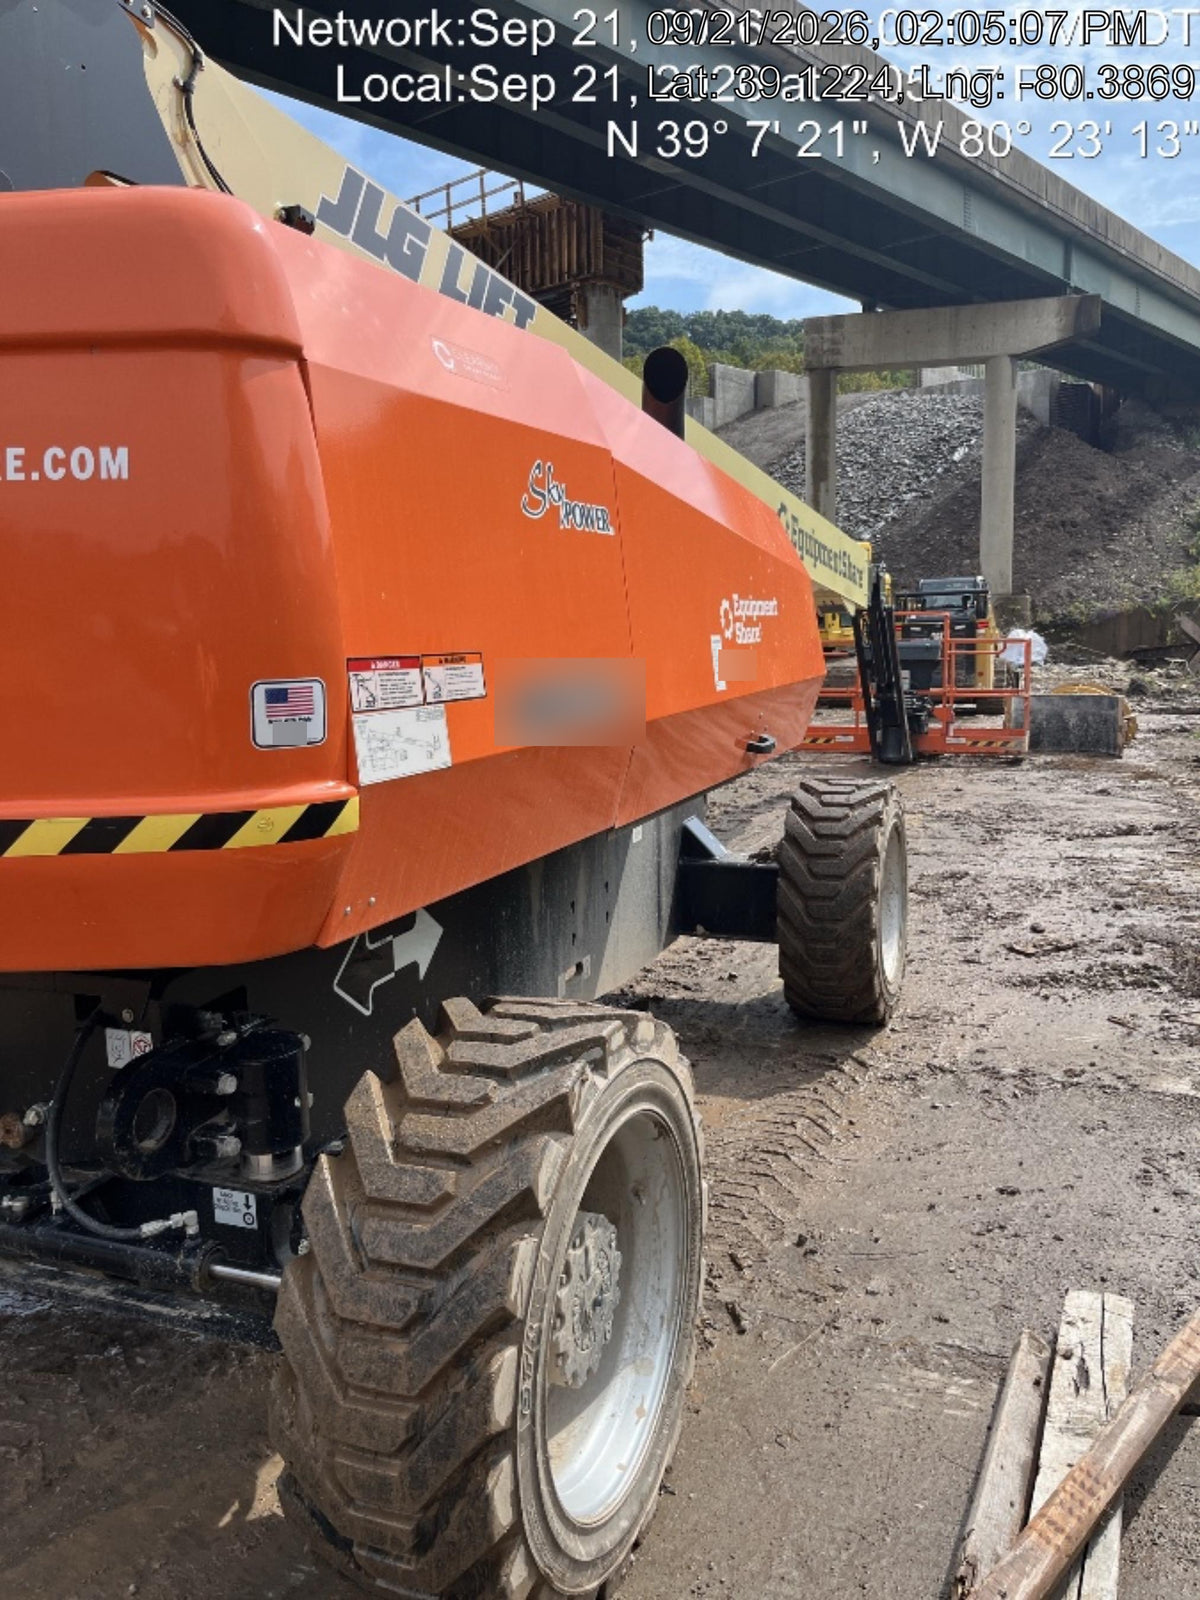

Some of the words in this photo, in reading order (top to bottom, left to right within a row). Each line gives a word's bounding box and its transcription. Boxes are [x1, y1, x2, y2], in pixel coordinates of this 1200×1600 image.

[315, 163, 432, 284] JLG
[438, 239, 538, 330] LIFT
[521, 459, 567, 519] Sky
[560, 499, 615, 536] POWER
[732, 593, 778, 621] Equipment
